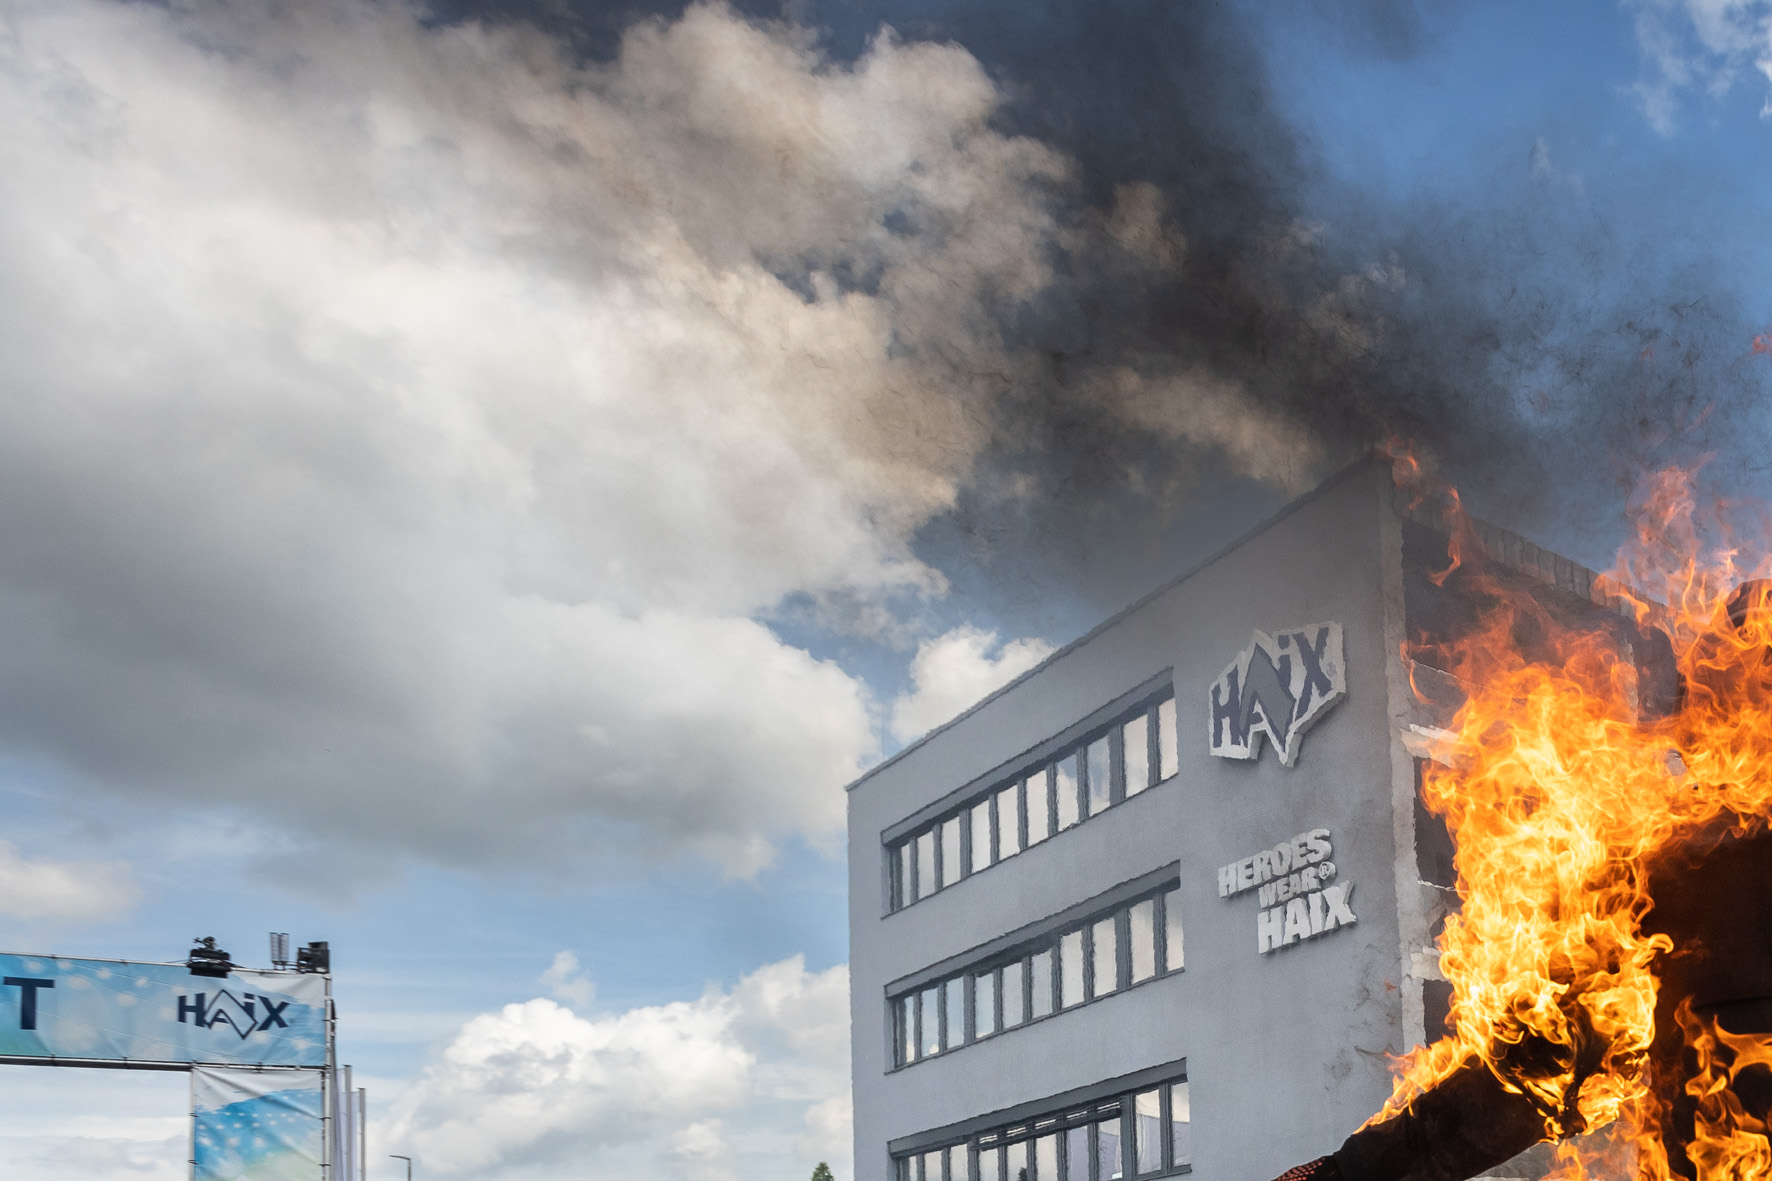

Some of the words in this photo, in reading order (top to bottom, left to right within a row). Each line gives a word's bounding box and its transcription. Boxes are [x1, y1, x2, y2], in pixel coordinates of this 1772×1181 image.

[1217, 828, 1332, 898] HEROES
[1258, 880, 1357, 954] HAIX
[177, 988, 289, 1040] HAIX
